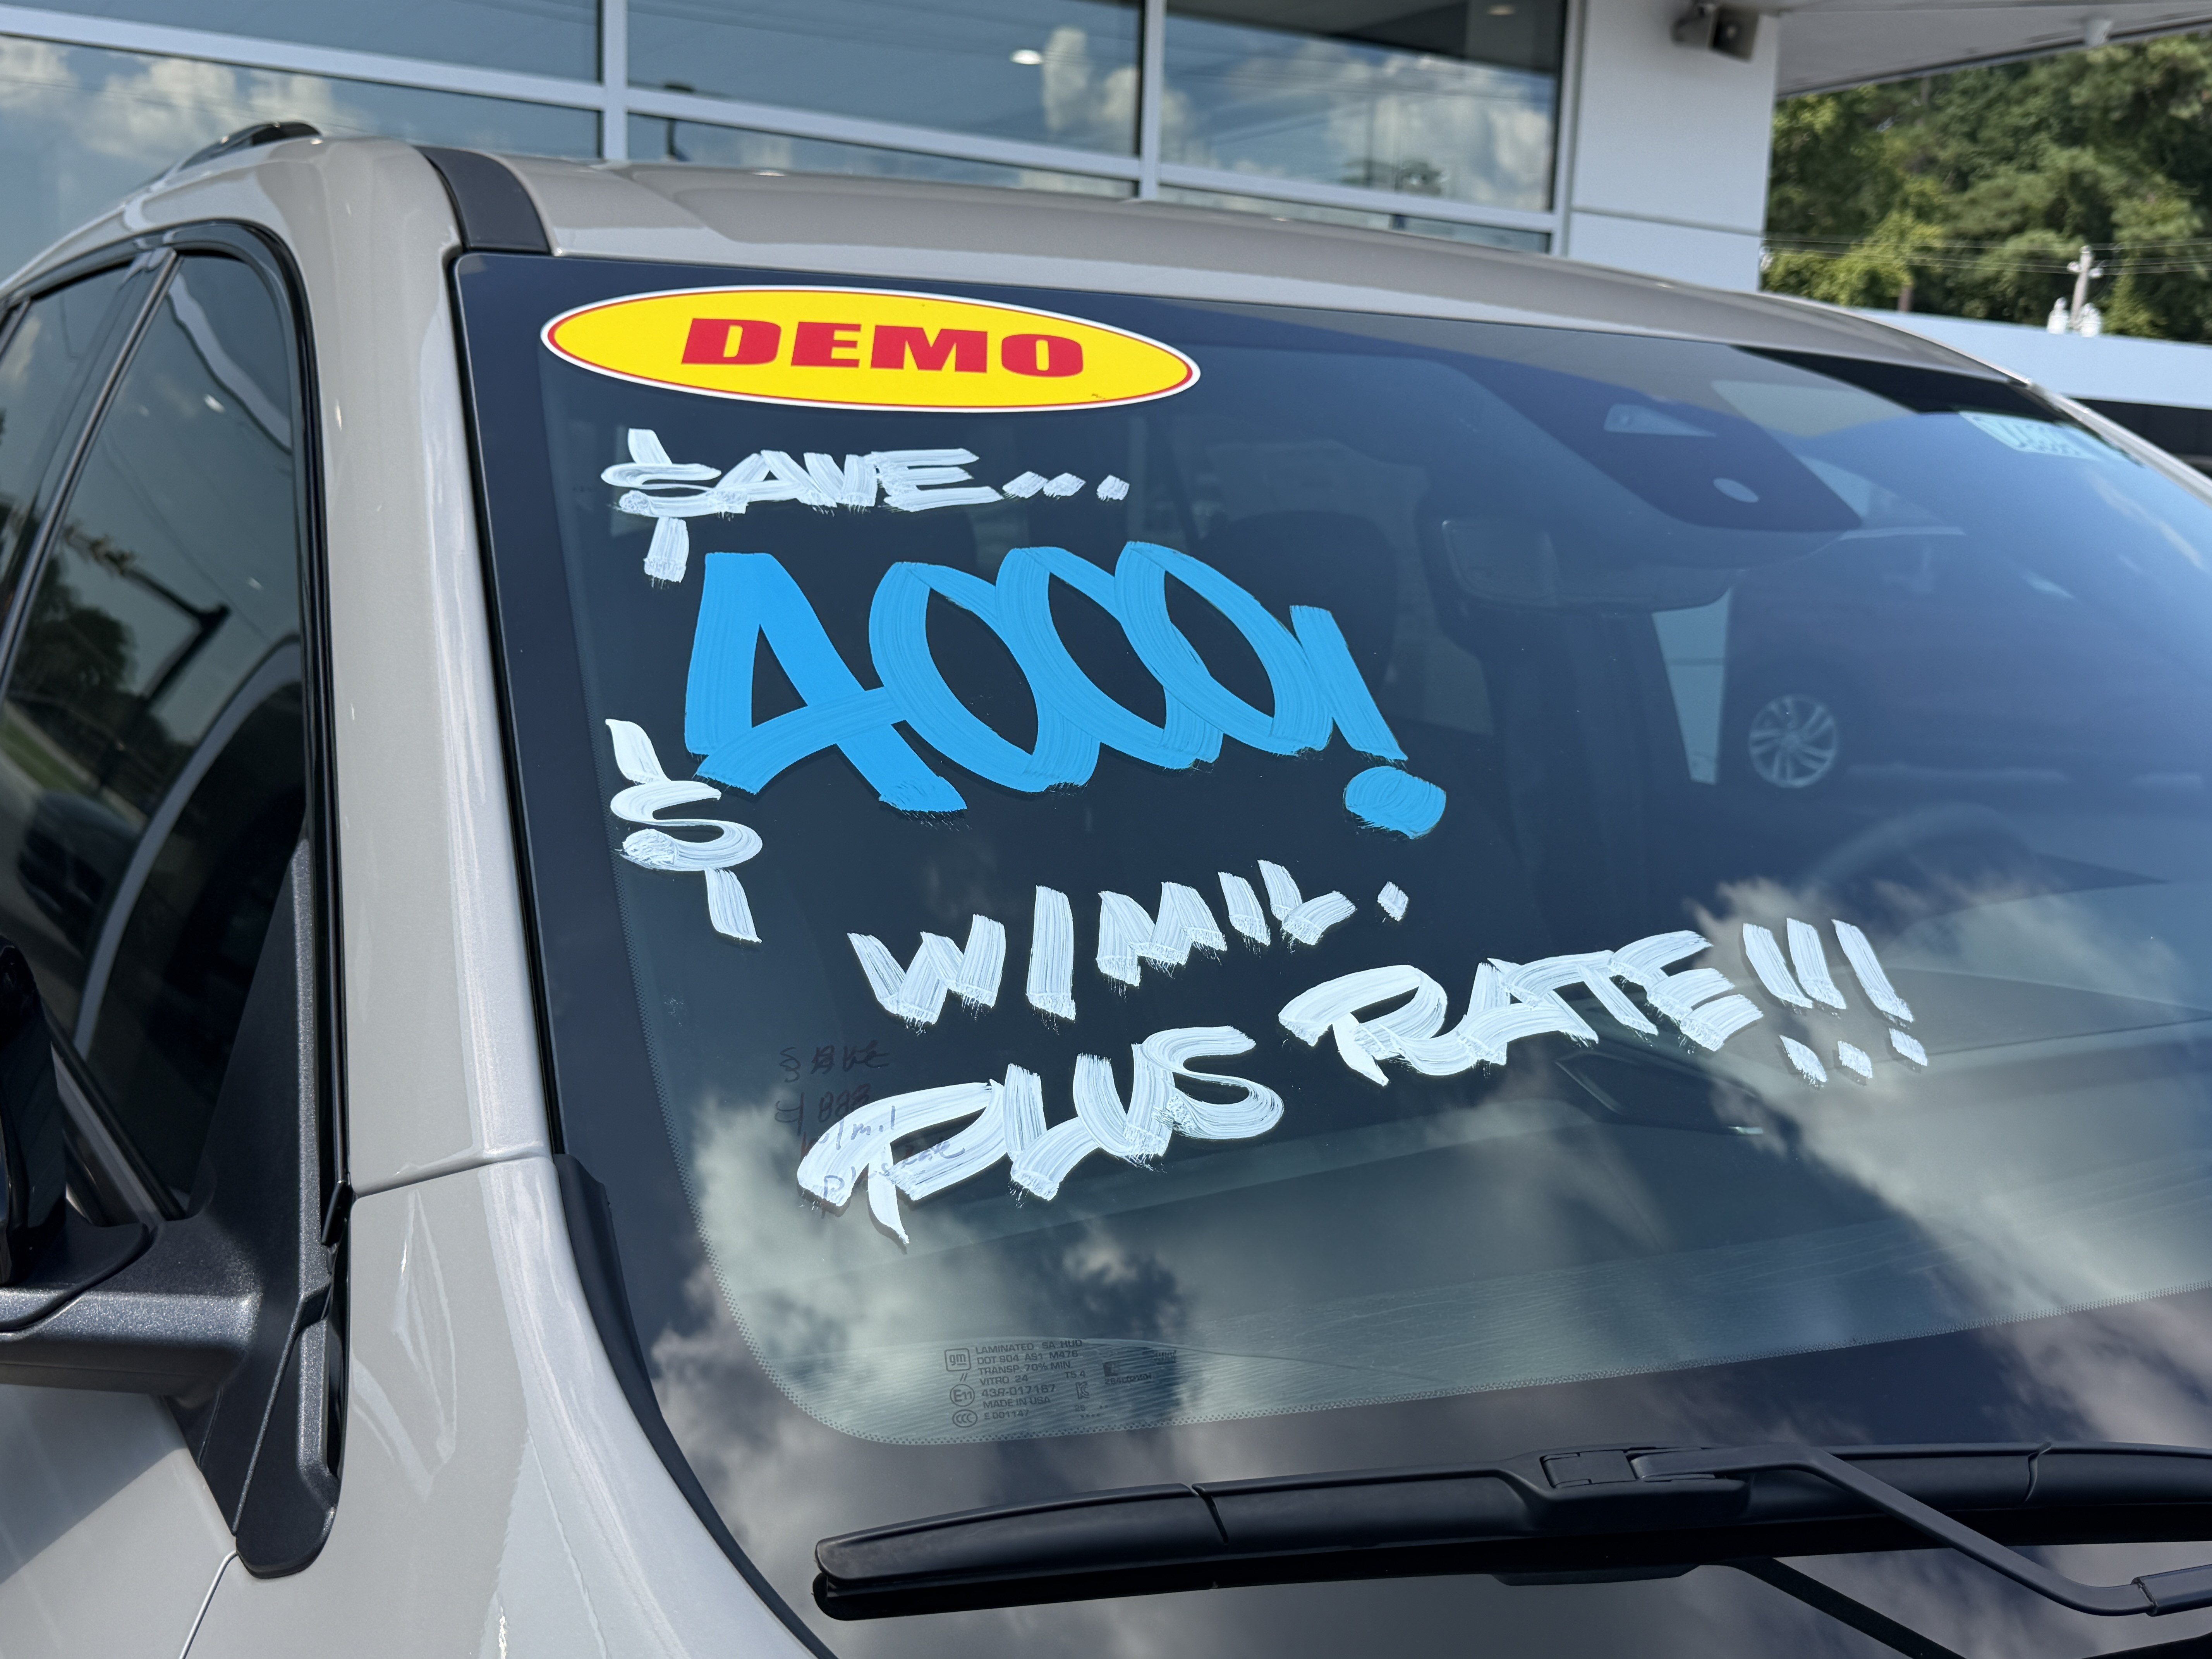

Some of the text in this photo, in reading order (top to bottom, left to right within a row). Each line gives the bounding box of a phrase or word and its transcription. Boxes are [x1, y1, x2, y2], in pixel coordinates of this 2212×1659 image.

[682, 319, 1083, 377] DEMO
[797, 1026, 1283, 1242] PLUS
[975, 1343, 1034, 1354] LAMINATED
[1060, 1339, 1082, 1348] HUD
[977, 1356, 997, 1364] DOT
[1024, 1362, 1048, 1372] 70%
[1051, 1361, 1071, 1370] MIN
[979, 1374, 1029, 1386] VITRO 24
[983, 1396, 1051, 1409] MADE IN USA
